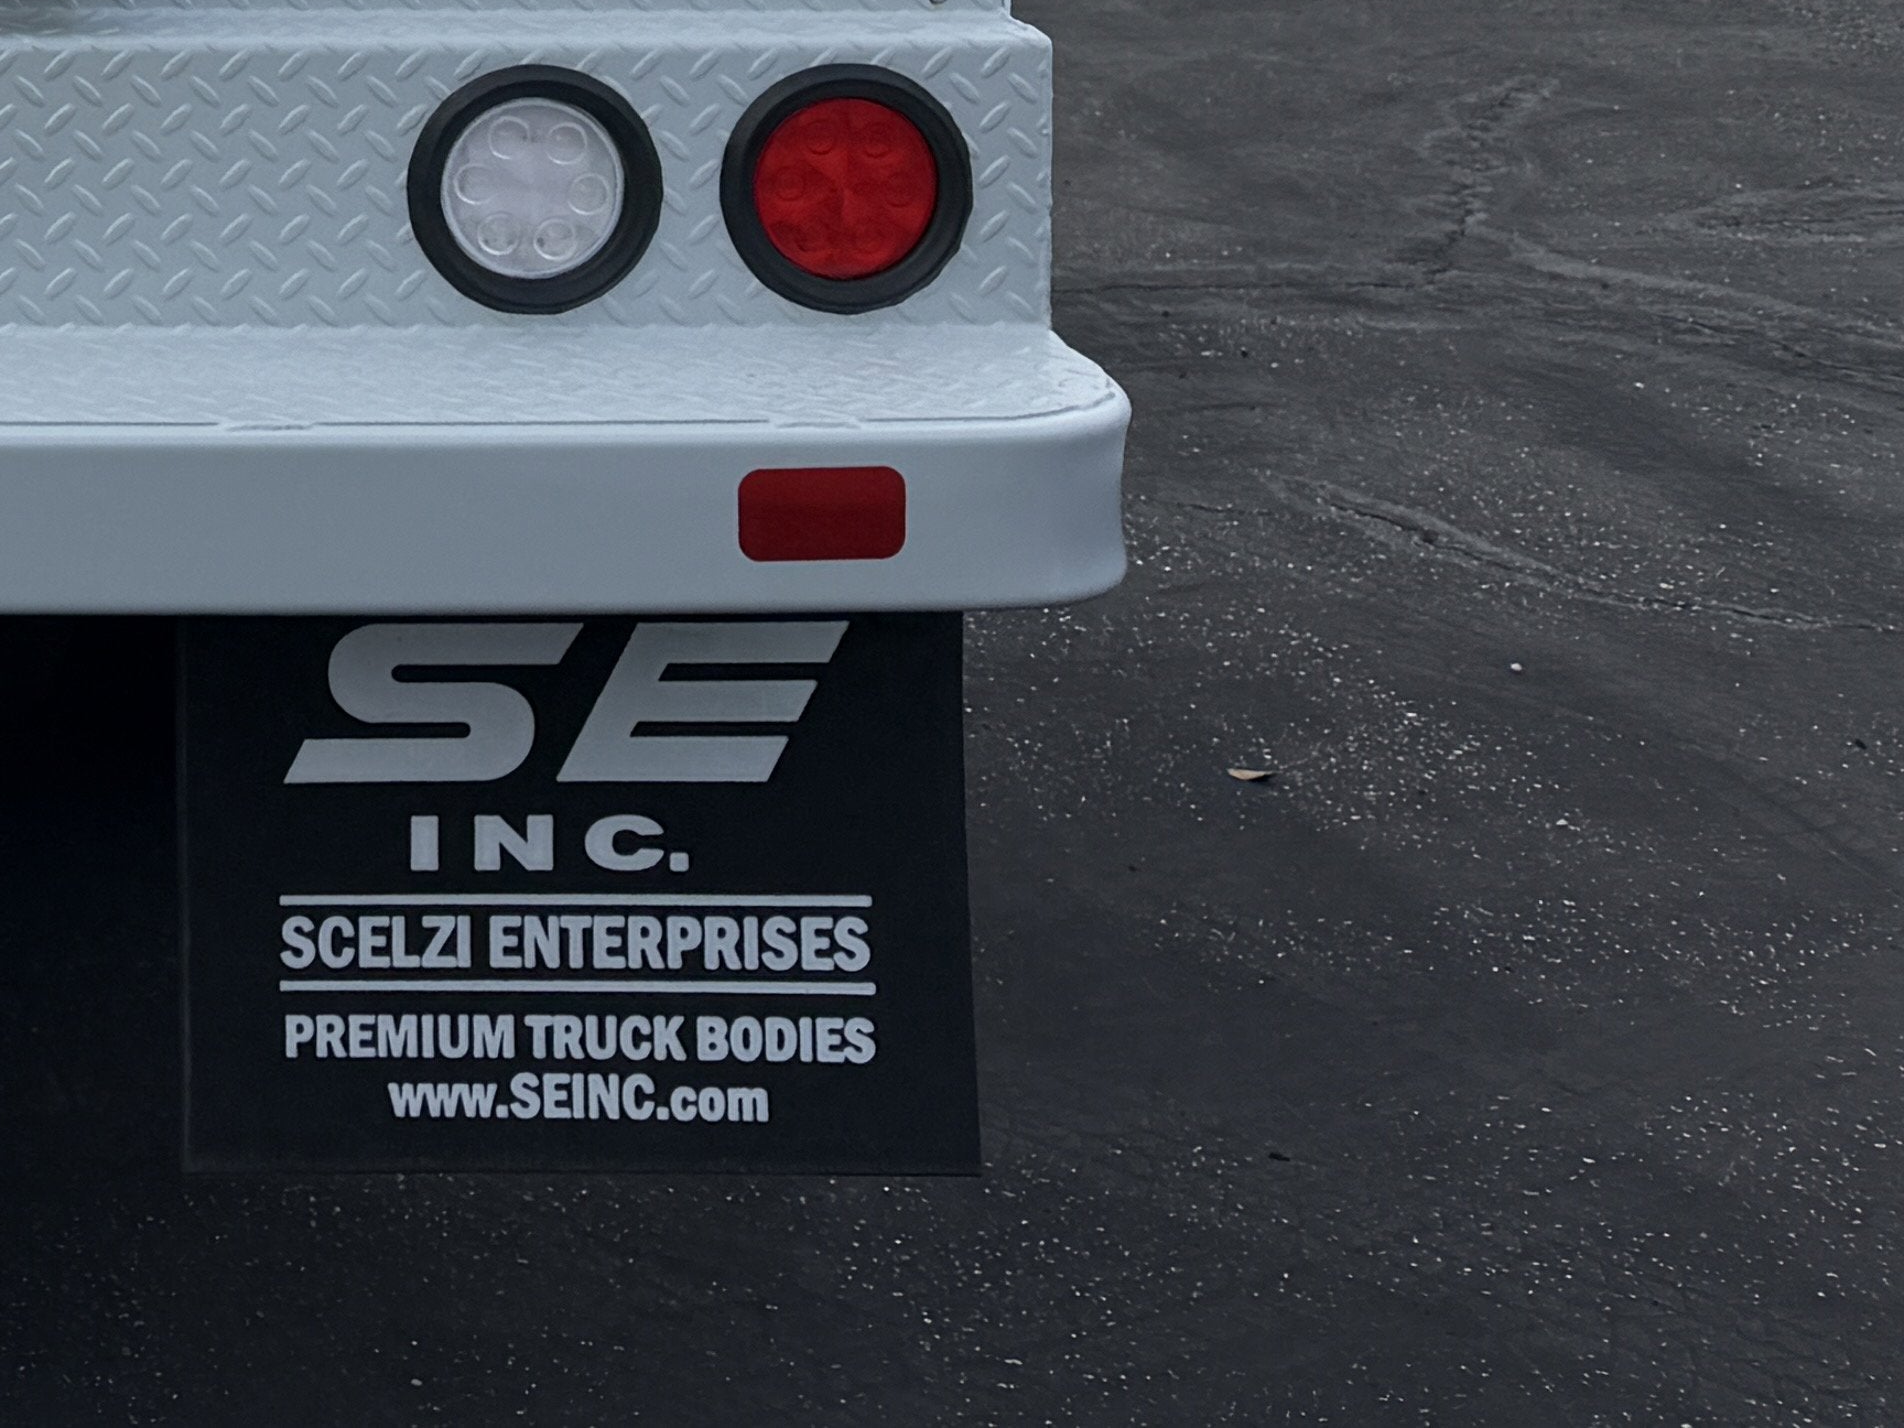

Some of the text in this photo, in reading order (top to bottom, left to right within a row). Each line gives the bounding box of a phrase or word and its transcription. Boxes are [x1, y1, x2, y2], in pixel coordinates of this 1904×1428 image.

[283, 620, 850, 784] SE
[410, 814, 691, 872] INC.
[279, 914, 872, 973] SCELZI ENTERPRISES
[284, 1013, 877, 1064] PREMIUM TRUCK BODIES
[388, 1072, 770, 1123] www.SEINC.com
